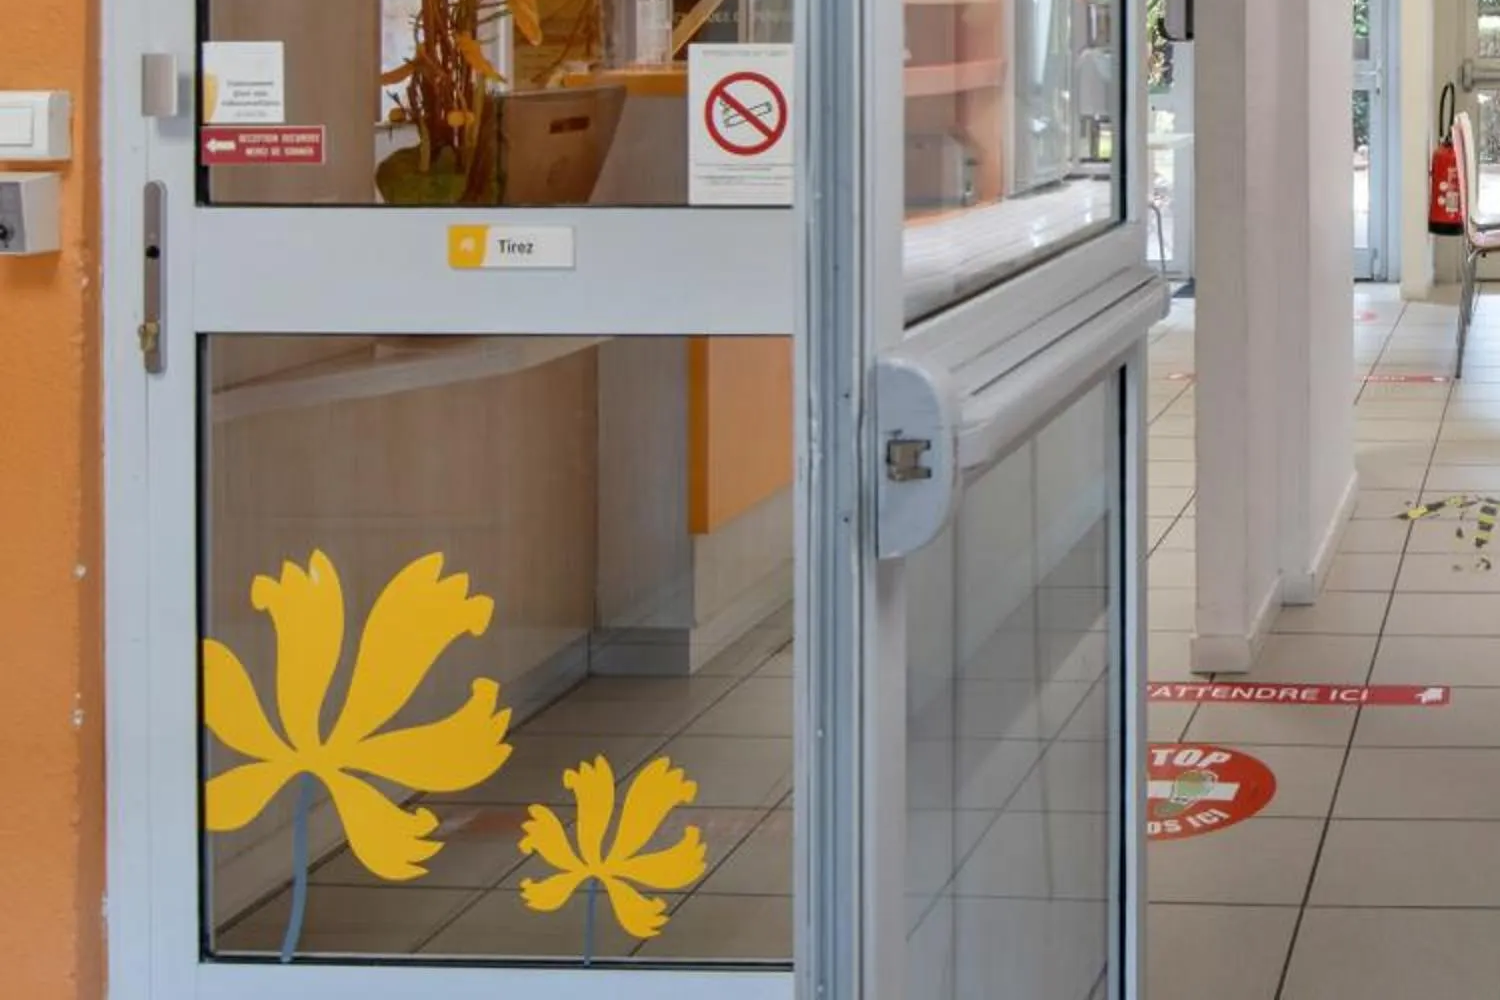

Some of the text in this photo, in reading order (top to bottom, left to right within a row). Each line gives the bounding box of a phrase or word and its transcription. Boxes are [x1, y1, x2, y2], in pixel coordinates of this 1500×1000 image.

[497, 238, 534, 255] Tirez
[1147, 684, 1370, 702] 'ATTENDRE ICI
[1150, 748, 1234, 768] TOP
[1186, 807, 1231, 830] ICI
